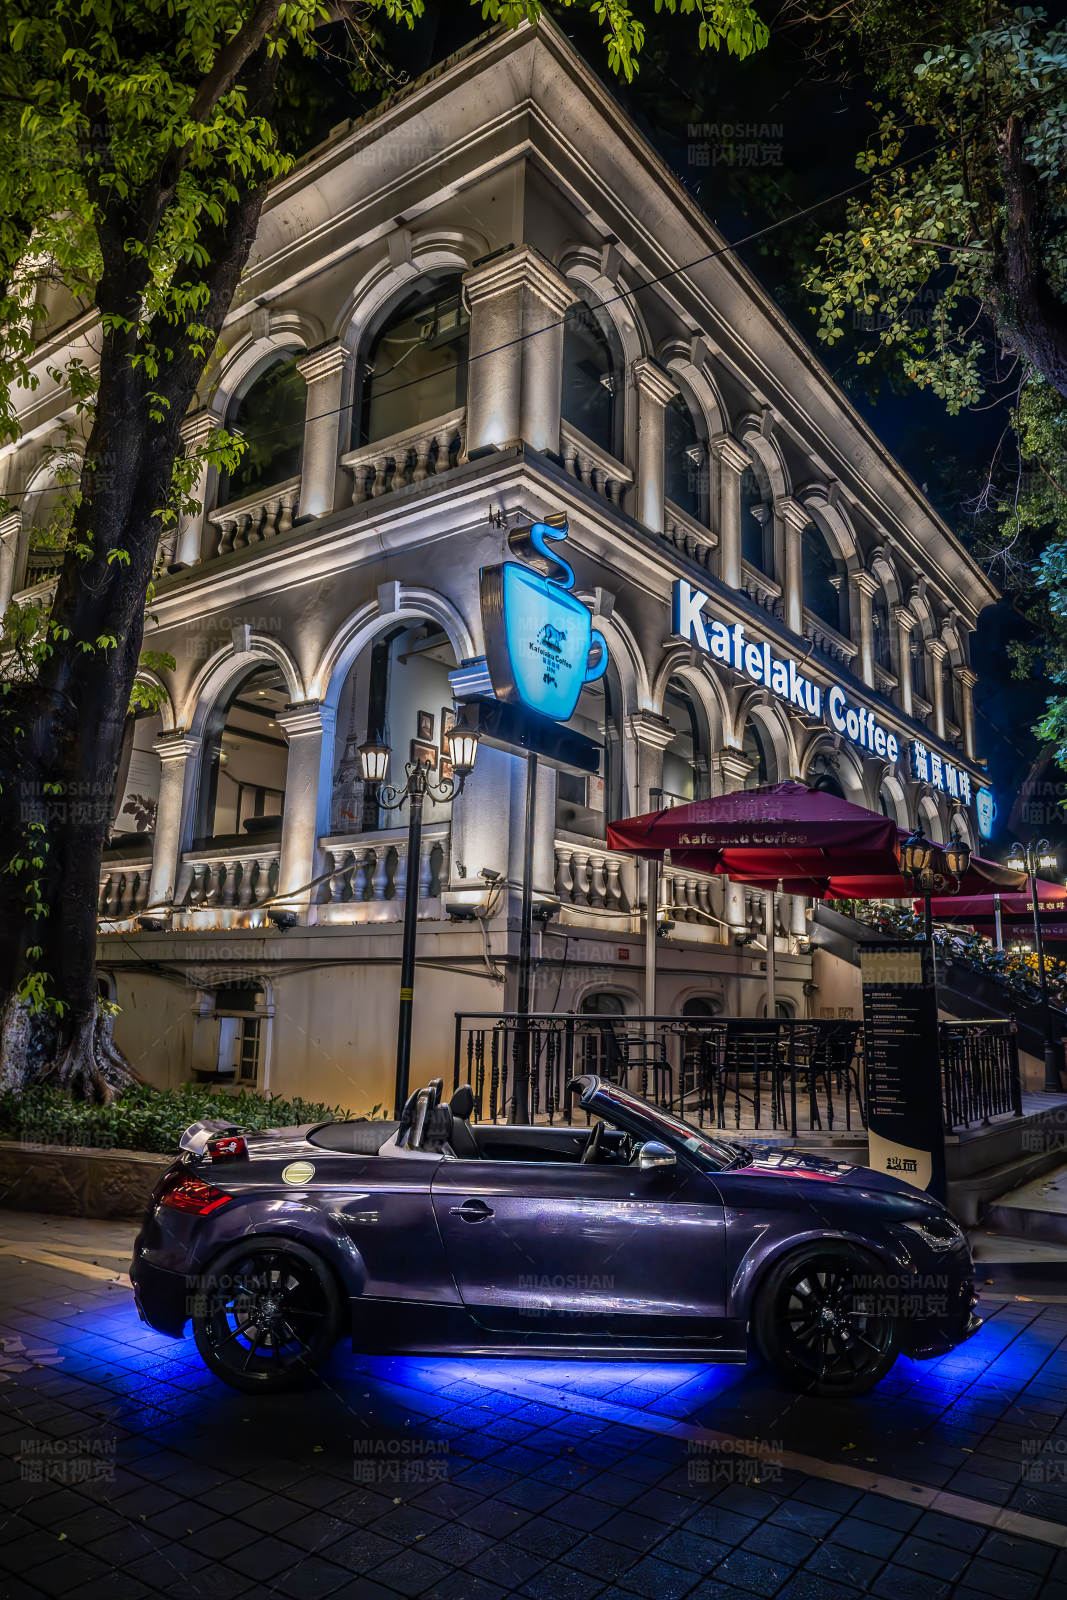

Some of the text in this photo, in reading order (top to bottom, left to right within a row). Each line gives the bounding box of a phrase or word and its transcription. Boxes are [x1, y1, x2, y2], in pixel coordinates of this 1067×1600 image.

[679, 579, 898, 763] Kafelaku Coffee
[914, 740, 971, 807] 猫屎咖啡
